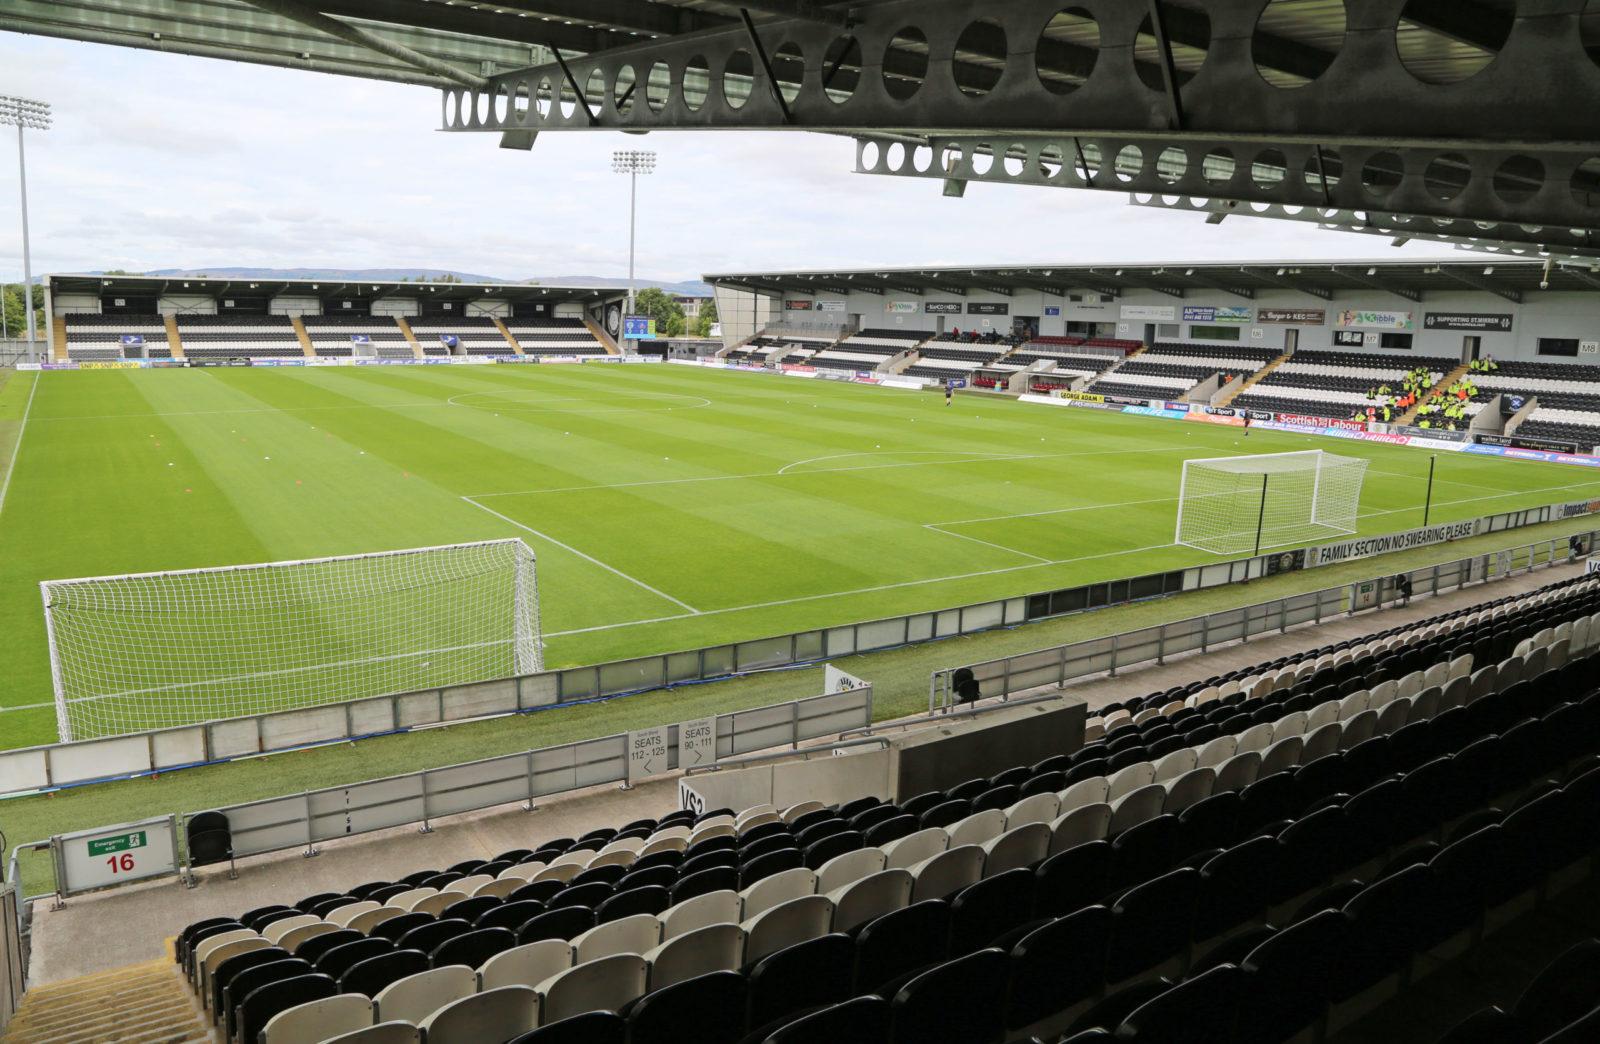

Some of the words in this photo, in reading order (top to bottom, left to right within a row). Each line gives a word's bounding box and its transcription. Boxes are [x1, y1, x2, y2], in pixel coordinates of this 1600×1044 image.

[1366, 336, 1376, 344] M7
[1581, 344, 1597, 353] M8
[1060, 392, 1080, 401] GEORGE
[1081, 394, 1098, 402] ADAM
[1218, 408, 1233, 417] Sport
[1252, 412, 1268, 420] Sport
[1280, 414, 1318, 427] Scottish
[1328, 418, 1362, 431] Labour
[1365, 432, 1397, 444] utilita
[1563, 501, 1588, 517] Impact
[1320, 543, 1353, 563] FAMILY
[1354, 536, 1391, 557] SECTION
[1391, 535, 1404, 549] NO
[1405, 526, 1445, 547] SWEARING
[1446, 522, 1472, 537] PLEASE
[685, 727, 710, 739] SEATS
[634, 736, 661, 748] SEATS
[685, 741, 694, 749] 90
[702, 738, 711, 746] 111
[632, 751, 644, 760] 112
[652, 746, 665, 756] 125
[95, 839, 125, 847] Emergency
[106, 853, 135, 873] 16
